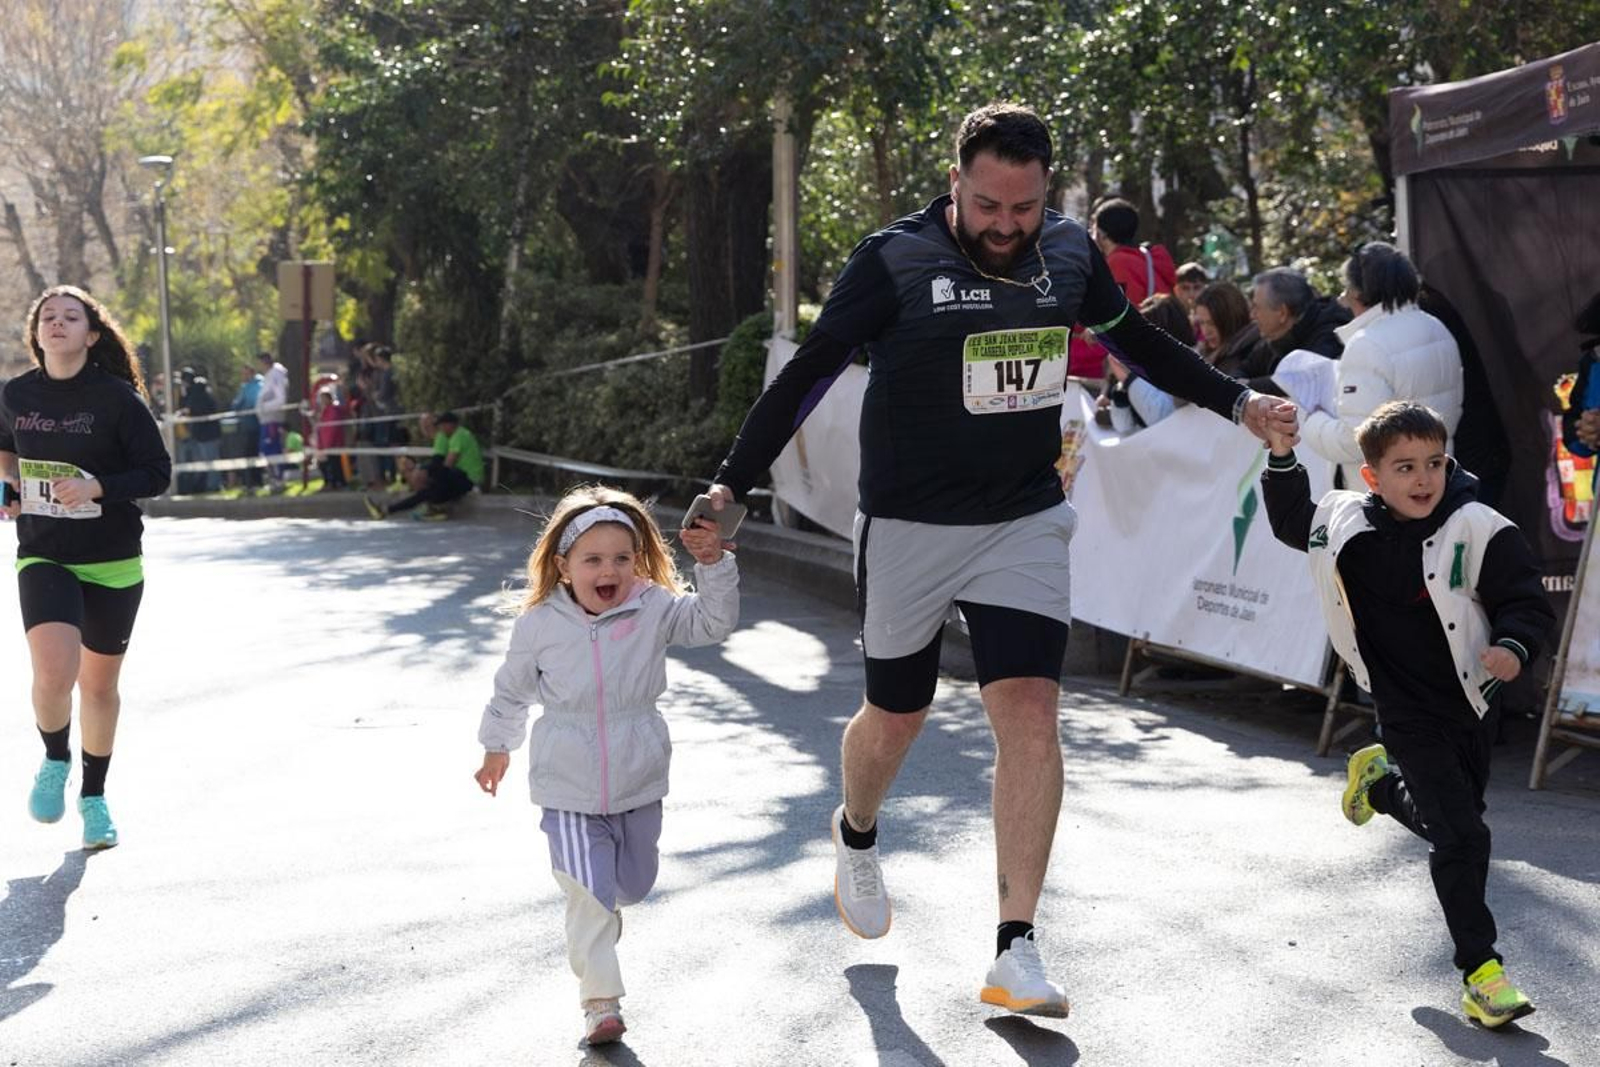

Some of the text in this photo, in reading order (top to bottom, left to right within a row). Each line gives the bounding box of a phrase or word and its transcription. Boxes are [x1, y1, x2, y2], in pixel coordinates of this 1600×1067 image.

[960, 289, 991, 301] LCH
[984, 334, 997, 345] SAN
[999, 333, 1017, 344] JUAN
[994, 358, 1042, 393] 147
[15, 412, 55, 432] nike
